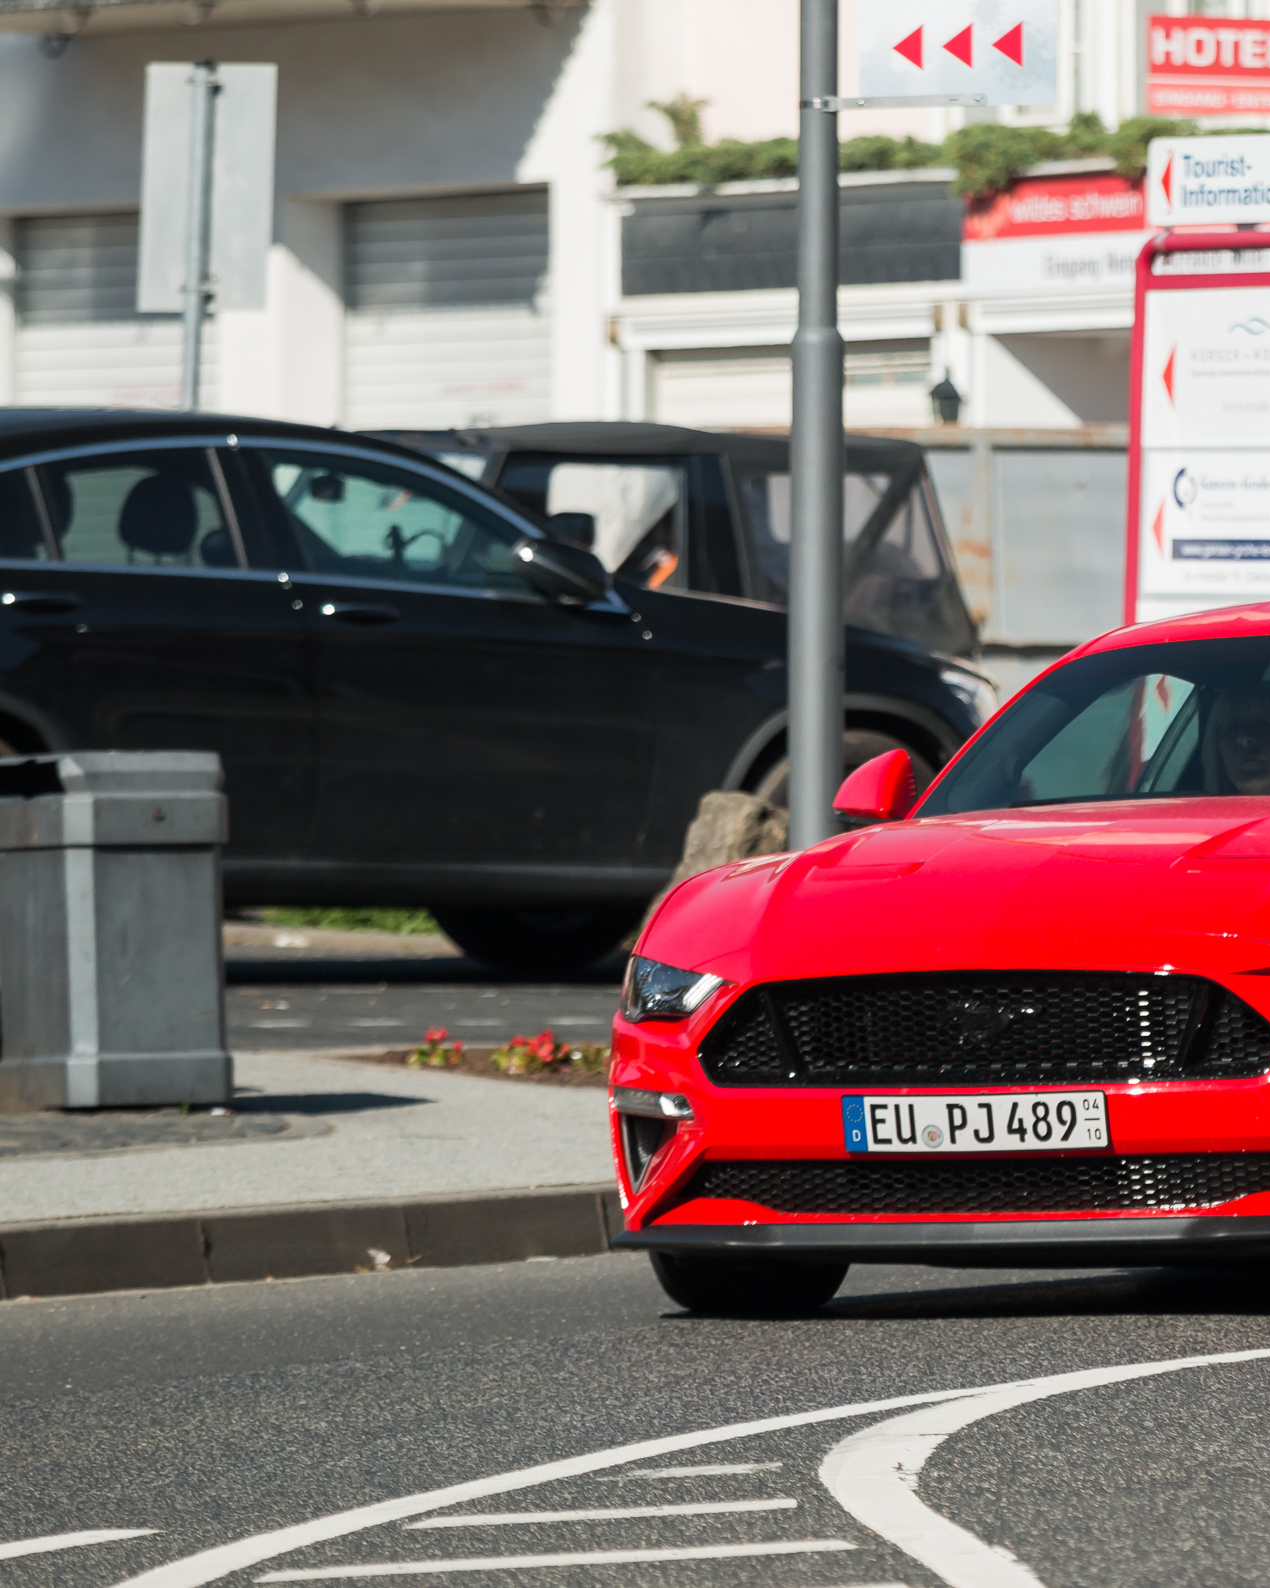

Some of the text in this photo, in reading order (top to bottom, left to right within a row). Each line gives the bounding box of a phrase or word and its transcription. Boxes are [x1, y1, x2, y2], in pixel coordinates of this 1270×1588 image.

[1183, 154, 1252, 178] Tourist-
[1083, 1098, 1100, 1111] 04
[869, 1100, 1078, 1145] EU PJ 489
[852, 1129, 861, 1142] D
[1086, 1128, 1102, 1141] 10
